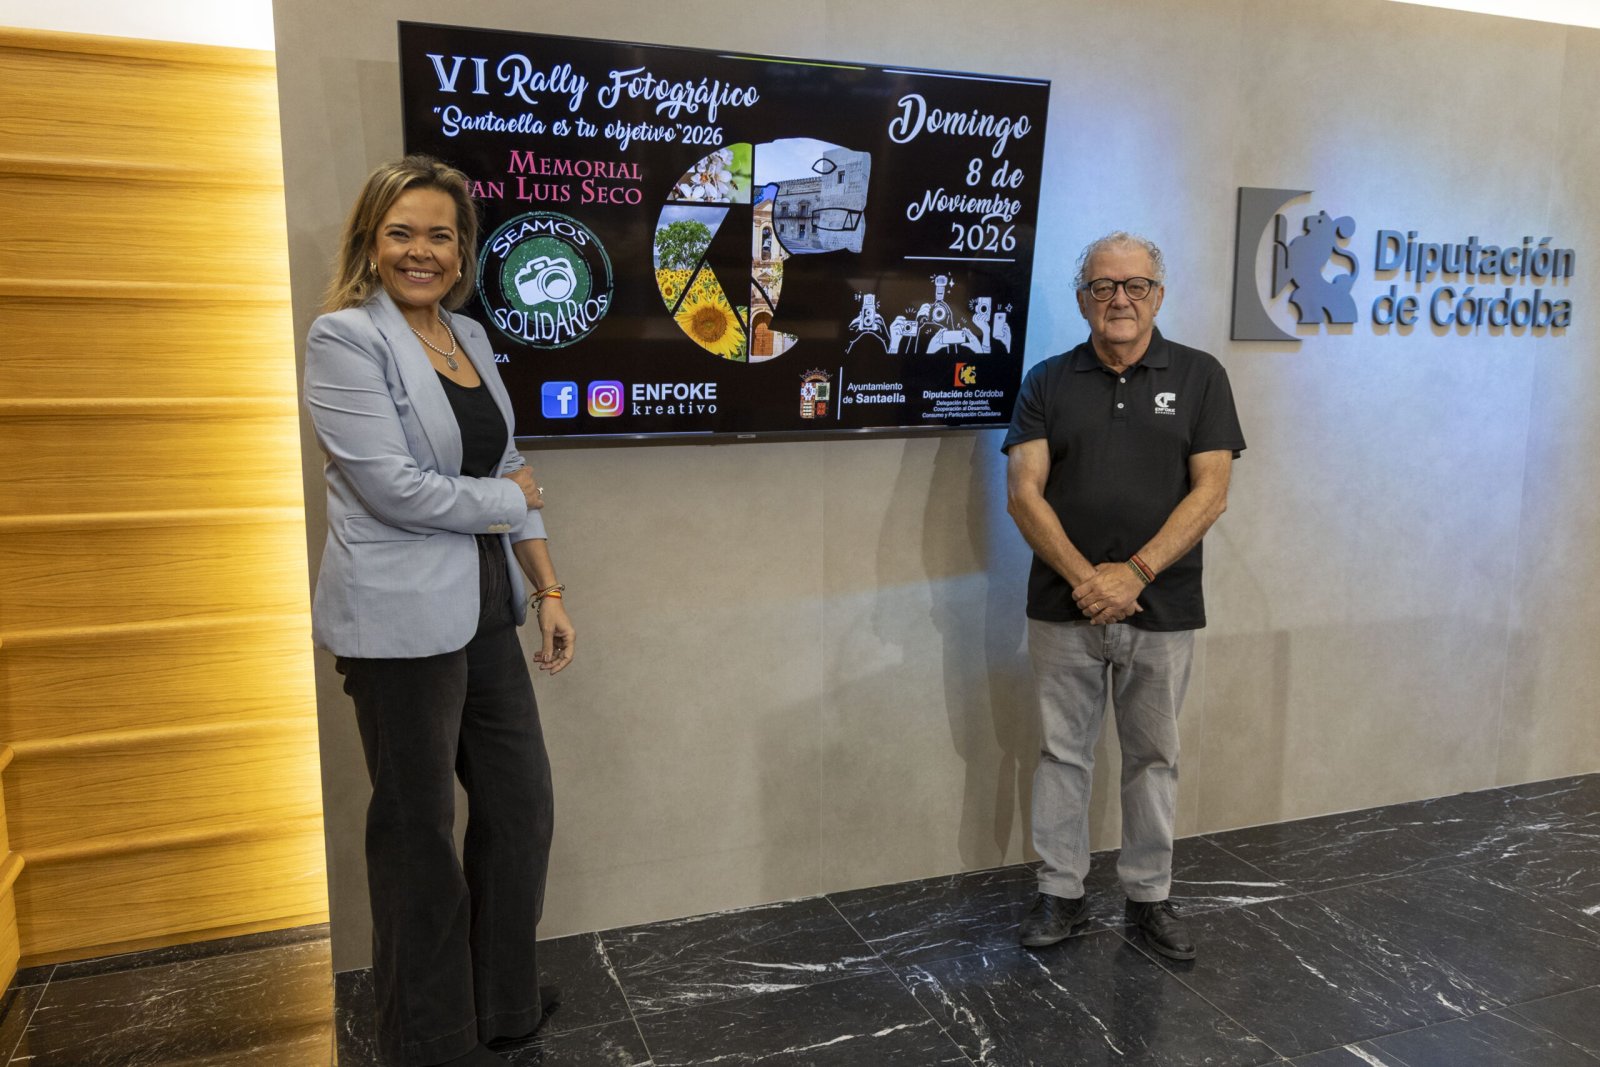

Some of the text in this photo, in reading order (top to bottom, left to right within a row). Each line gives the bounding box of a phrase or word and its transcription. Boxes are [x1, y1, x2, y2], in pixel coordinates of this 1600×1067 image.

[496, 53, 589, 112] Rally
[597, 66, 760, 123] Fotográfico
[433, 106, 546, 137] "Santaella
[552, 122, 571, 136] es
[574, 117, 598, 137] tu
[682, 125, 723, 146] 2026
[888, 93, 1032, 158] Domingo
[507, 150, 643, 182] MEMORIAL
[965, 158, 1025, 189] 8 de
[515, 176, 571, 203] LUIS
[581, 180, 642, 205] SECO
[906, 187, 1022, 225] Noviembre
[492, 219, 590, 259] SEAMOS
[948, 222, 1017, 253] 2026
[1375, 229, 1577, 284] Diputación
[494, 294, 608, 344] SOLIDARIOS
[1371, 285, 1573, 329] de Córdoba
[631, 383, 717, 400] ENFOKE
[842, 393, 906, 404] de Santaella
[847, 382, 903, 392] Ayuntamiento
[922, 389, 1004, 400] Diputación de Córdoba
[632, 402, 718, 416] kreativo
